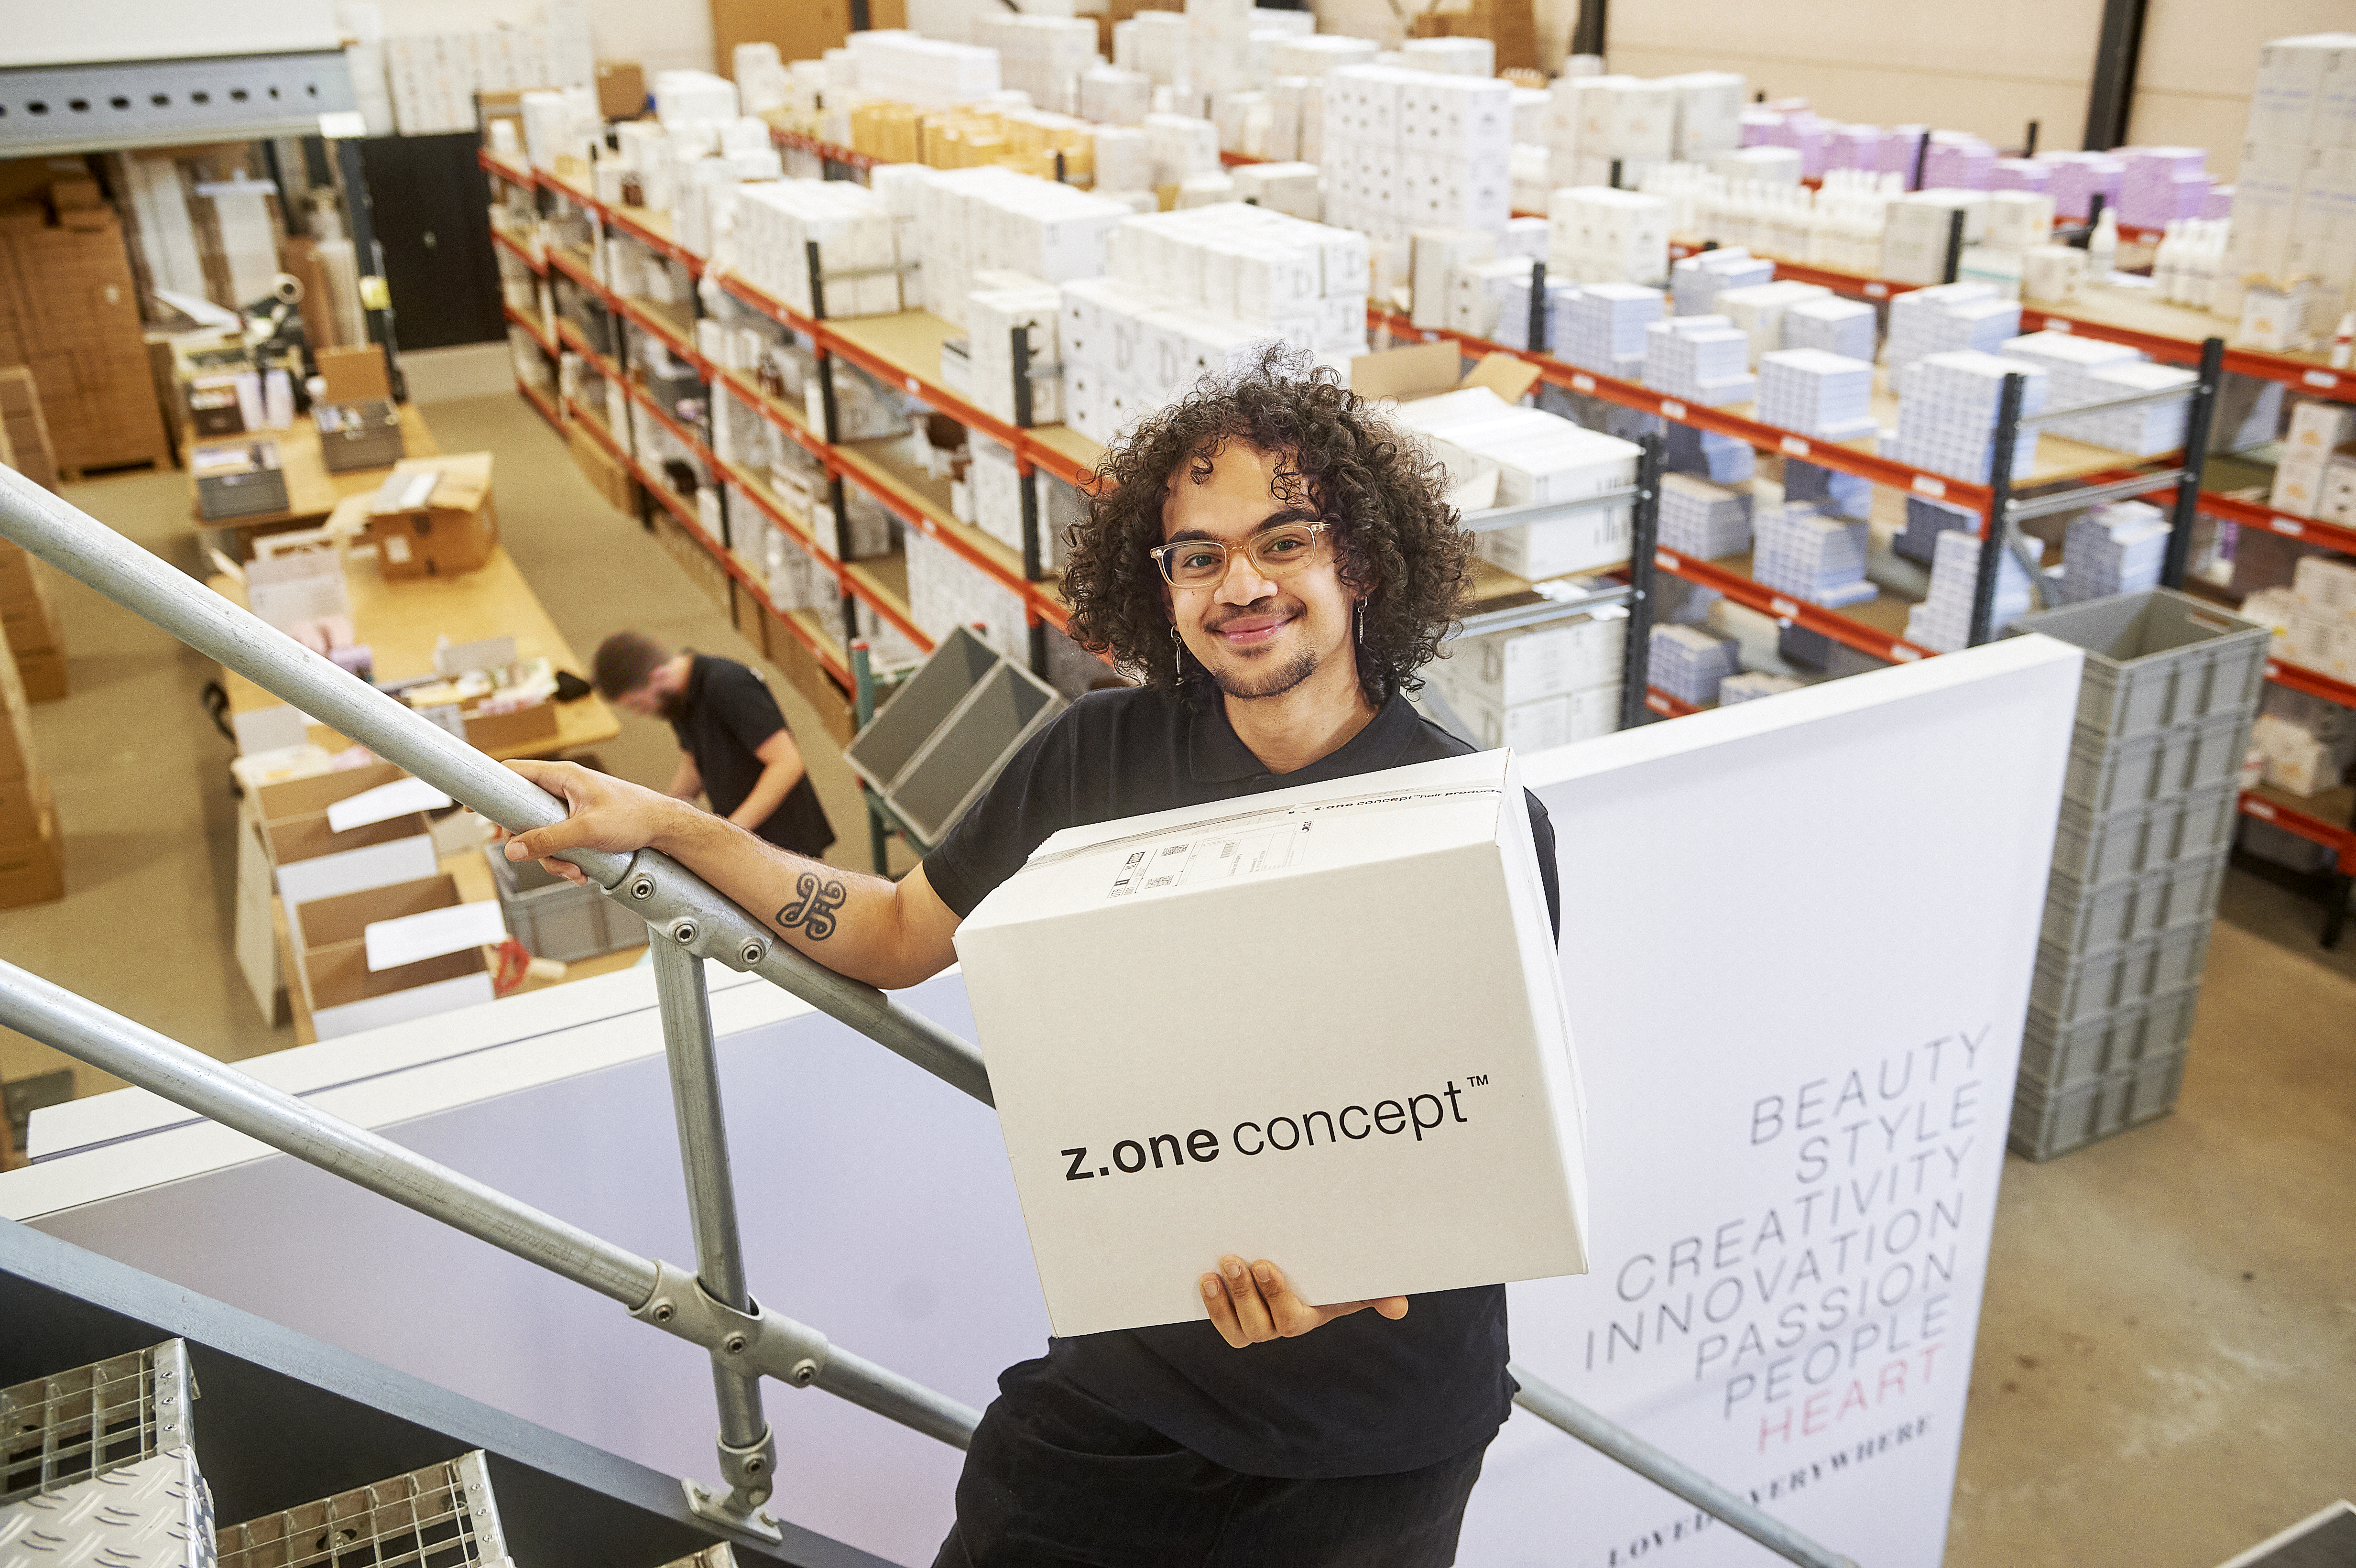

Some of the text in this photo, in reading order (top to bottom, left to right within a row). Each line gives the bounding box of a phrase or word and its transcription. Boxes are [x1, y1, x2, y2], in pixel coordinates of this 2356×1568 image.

[1313, 803, 1353, 811] z.one
[1750, 1023, 1991, 1147] BEAUTY
[1795, 1079, 1981, 1186] STYLE
[1060, 1129, 1220, 1181] z.one
[1615, 1136, 1975, 1304] CREATIVITY
[1584, 1191, 1963, 1372] INNOVATION
[1694, 1244, 1957, 1382] PASSION
[1722, 1292, 1951, 1420] PEOPLE
[1757, 1342, 1944, 1454] HEART
[1748, 1413, 1933, 1505] VERYWHERE
